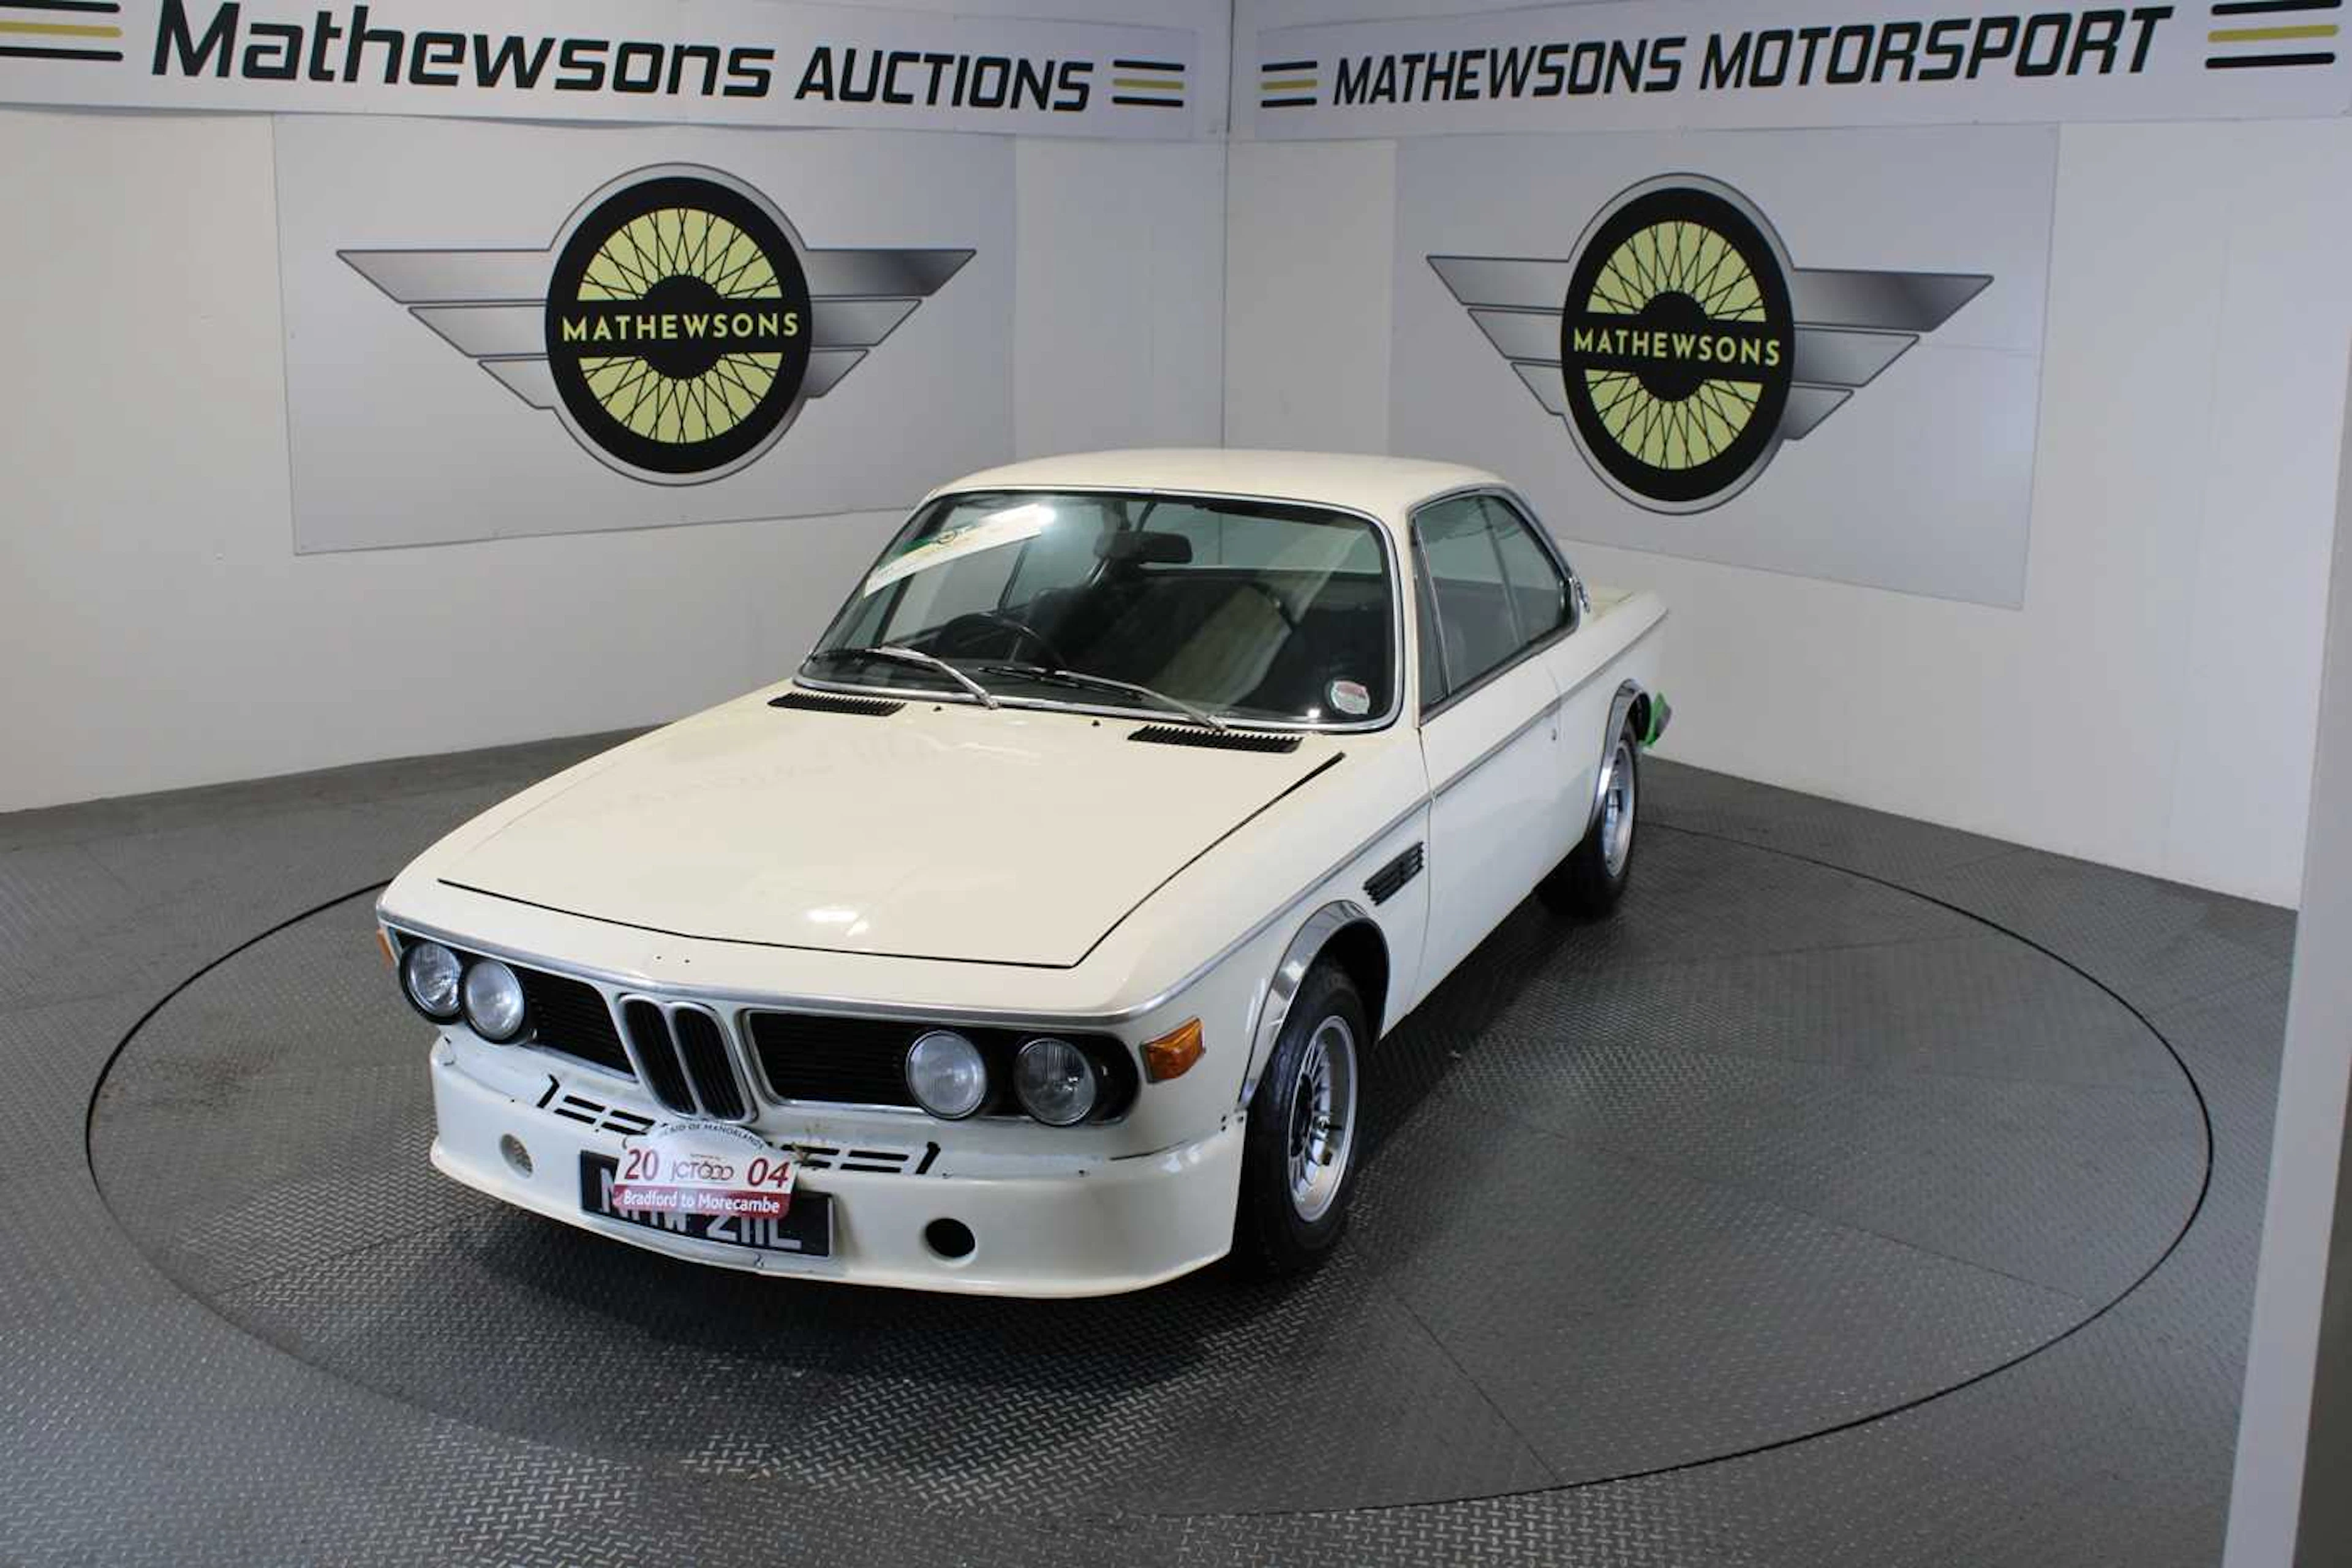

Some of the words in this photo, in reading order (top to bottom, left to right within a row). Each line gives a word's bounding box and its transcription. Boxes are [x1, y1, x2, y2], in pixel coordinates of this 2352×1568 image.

[152, 0, 774, 98] Mathewsons
[795, 47, 1093, 111] AUCTIONS
[1333, 36, 1687, 105] MATHEWSONS
[1700, 6, 2174, 90] MOTORSPORT
[562, 312, 798, 342] MATHEWSONS
[1573, 326, 1781, 367] MATHEWSONS
[625, 1148, 660, 1181] 20
[747, 1157, 791, 1189] 04
[623, 1189, 677, 1207] Bradford
[680, 1193, 695, 1208] to
[698, 1194, 780, 1213] Morecambe
